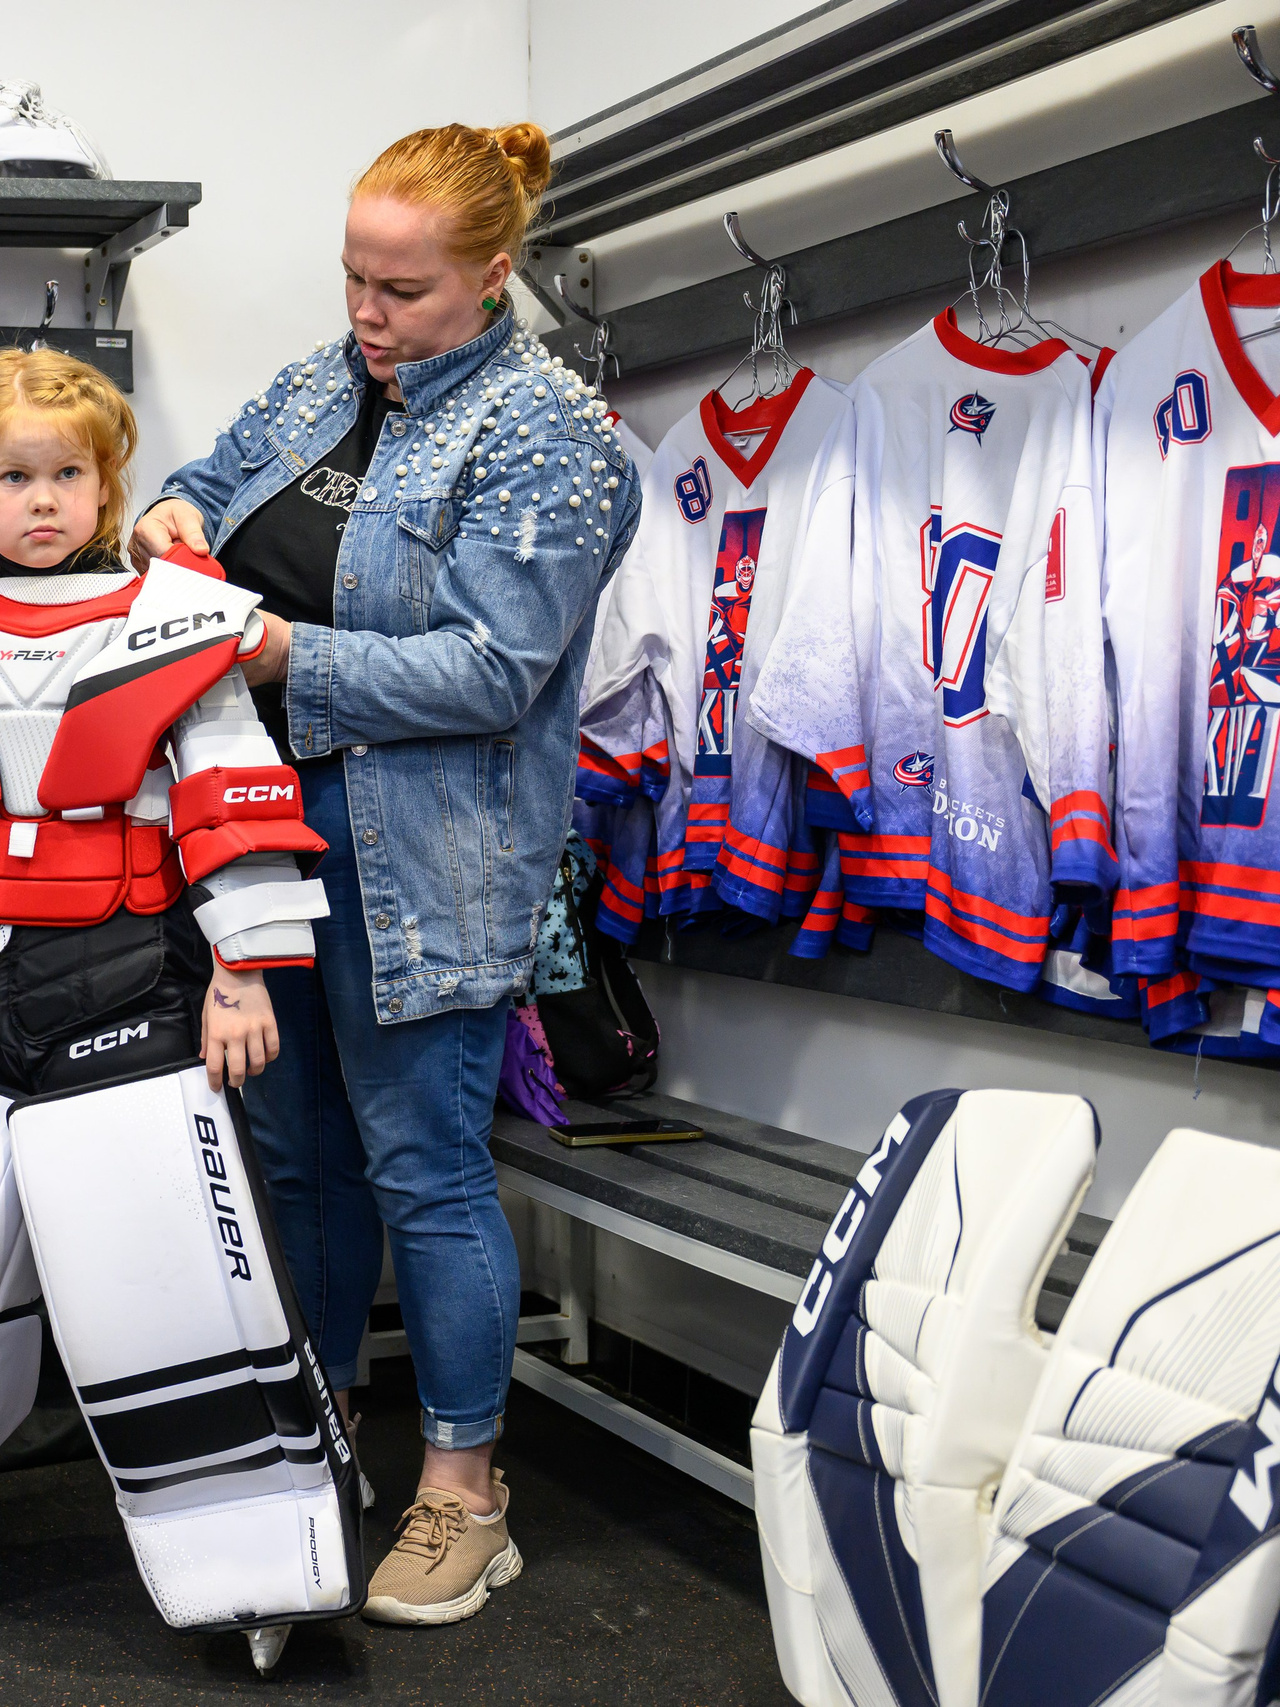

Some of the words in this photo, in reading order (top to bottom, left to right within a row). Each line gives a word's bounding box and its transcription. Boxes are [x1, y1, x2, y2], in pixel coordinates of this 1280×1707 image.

[128, 611, 226, 652] CCM
[223, 784, 295, 804] CCM
[950, 799, 1007, 829] CKETS
[68, 1021, 149, 1060] CCM
[792, 1111, 911, 1338] CCM
[308, 1516, 322, 1590] PRODIGY
